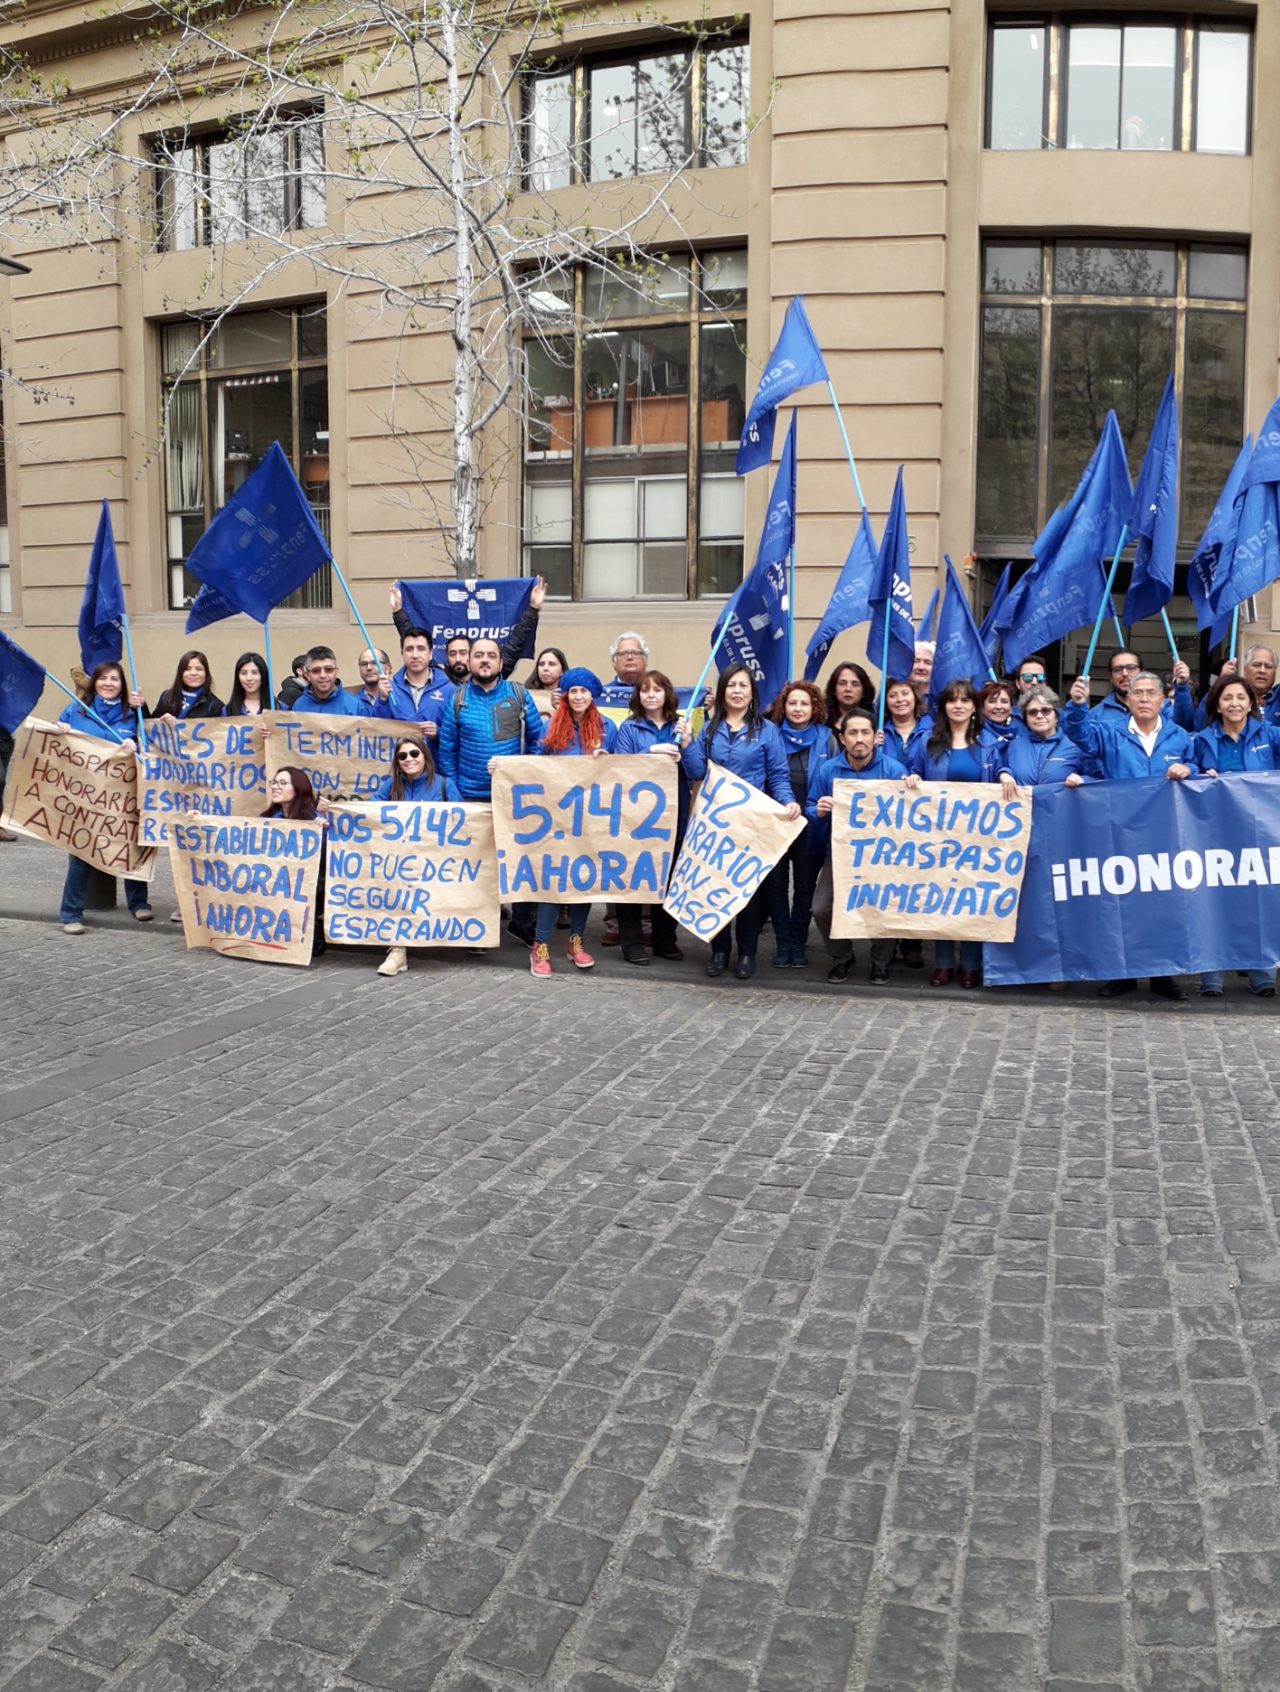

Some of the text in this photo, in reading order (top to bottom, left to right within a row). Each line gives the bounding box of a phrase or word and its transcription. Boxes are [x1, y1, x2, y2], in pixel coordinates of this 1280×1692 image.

[36, 730, 137, 783] TRASPASO
[227, 725, 254, 755] DE
[24, 783, 41, 801] A
[31, 757, 140, 817] HONORARIO
[700, 768, 752, 829] 42
[54, 796, 139, 843] CONTRAT
[328, 805, 472, 847] LOS 5.142
[511, 780, 671, 845] 5.142
[848, 789, 1023, 840] EXIGIMOS
[175, 822, 320, 861] ESTABILIDAD
[852, 836, 1023, 877] TRASPASO
[190, 857, 308, 903] LABORAL
[329, 850, 482, 883] NO PUEDEN
[499, 849, 671, 900] ¡AHORA!
[328, 884, 431, 917] SEGUIR
[667, 882, 721, 935] PASO
[706, 887, 739, 917] EL
[847, 875, 1019, 919] INMEDIATO
[329, 914, 486, 942] ESPERANDO
